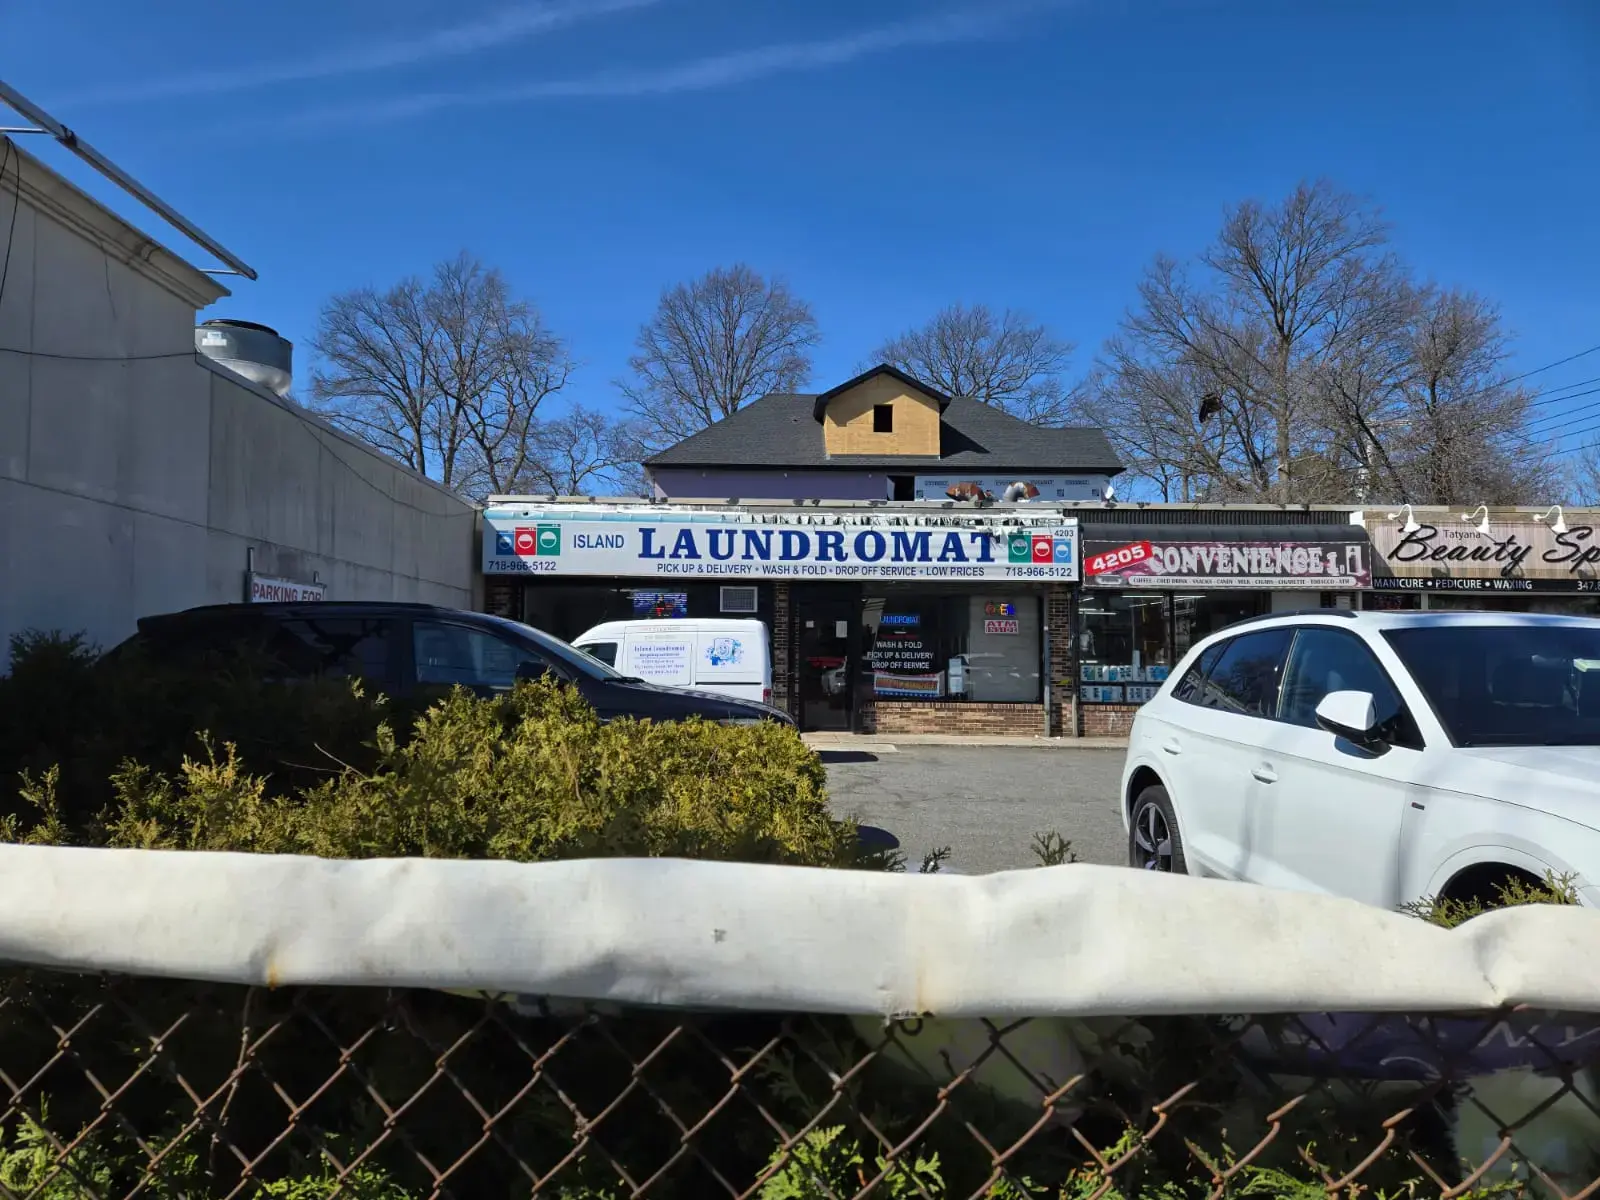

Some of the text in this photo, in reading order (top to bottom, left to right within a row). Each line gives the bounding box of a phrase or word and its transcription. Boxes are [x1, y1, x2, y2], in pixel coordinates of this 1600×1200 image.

[1054, 529, 1074, 537] 4203
[1443, 529, 1481, 539] Tatyana
[573, 527, 996, 562] ISLAND LAUNDROMAT
[1387, 524, 1532, 576] Beauty
[1092, 545, 1146, 571] 4205
[1148, 546, 1323, 575] CONVENIENCE
[488, 561, 557, 571] 718-966-5122
[657, 563, 985, 577] PICK UP & DELIVERY WASH & FOLD DROP OFF SERVICE LOW PRICES
[1005, 567, 1073, 577] 718-966-5122
[1374, 578, 1533, 590] MANICURE PEDICURE WAXING
[252, 582, 298, 602] PARKING
[876, 641, 896, 649] WASH
[905, 641, 923, 649] FOLD
[867, 651, 934, 659] PICK UP & DELIVERY
[872, 661, 930, 669] DROP OFF SERVICE
